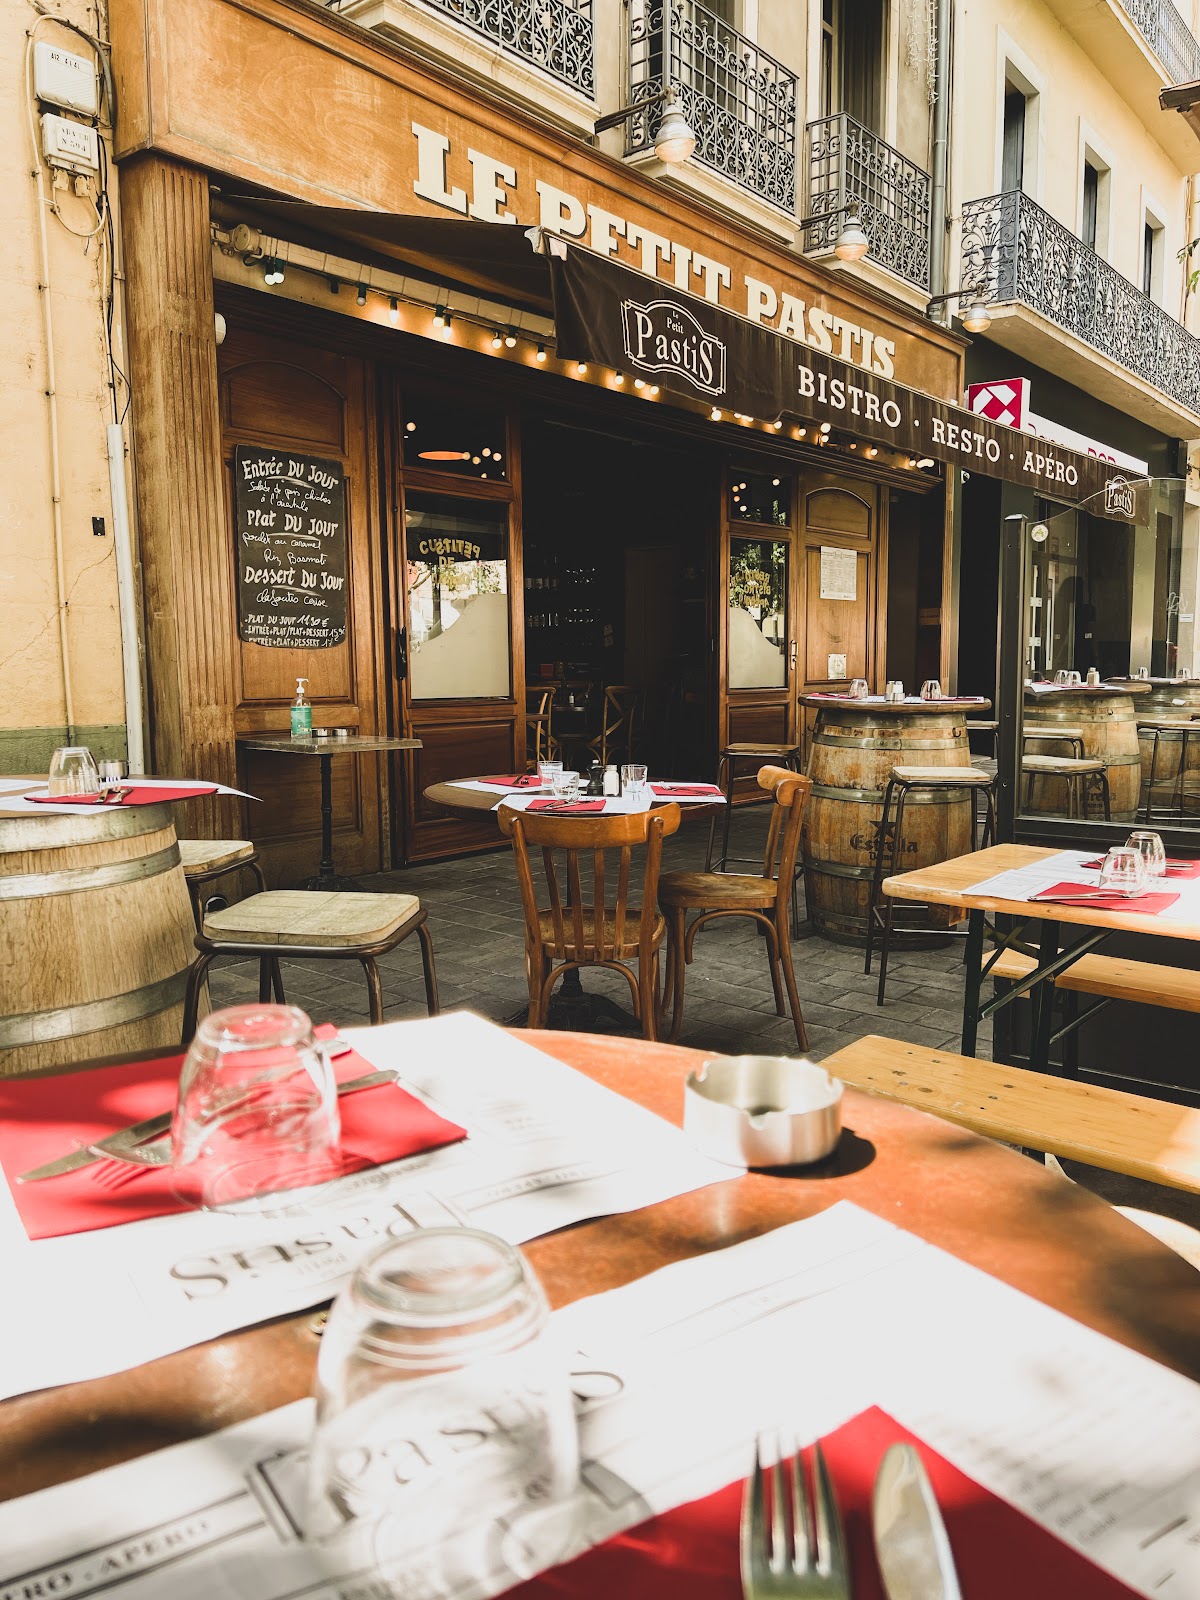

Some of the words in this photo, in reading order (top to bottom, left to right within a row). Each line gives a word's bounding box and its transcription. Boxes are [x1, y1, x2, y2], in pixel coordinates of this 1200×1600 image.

[411, 121, 518, 224] LE
[535, 178, 731, 306] PETIT
[744, 274, 896, 380] PASTIS
[666, 316, 684, 335] Petit
[798, 365, 902, 428] BISTRO
[931, 417, 1001, 463] RESTO
[1022, 452, 1079, 486] APÉRO
[287, 459, 304, 478] DU
[246, 509, 277, 527] Plat
[284, 514, 302, 532] DU
[244, 565, 296, 586] Dessert
[300, 568, 317, 589] DU
[267, 615, 278, 624] DU
